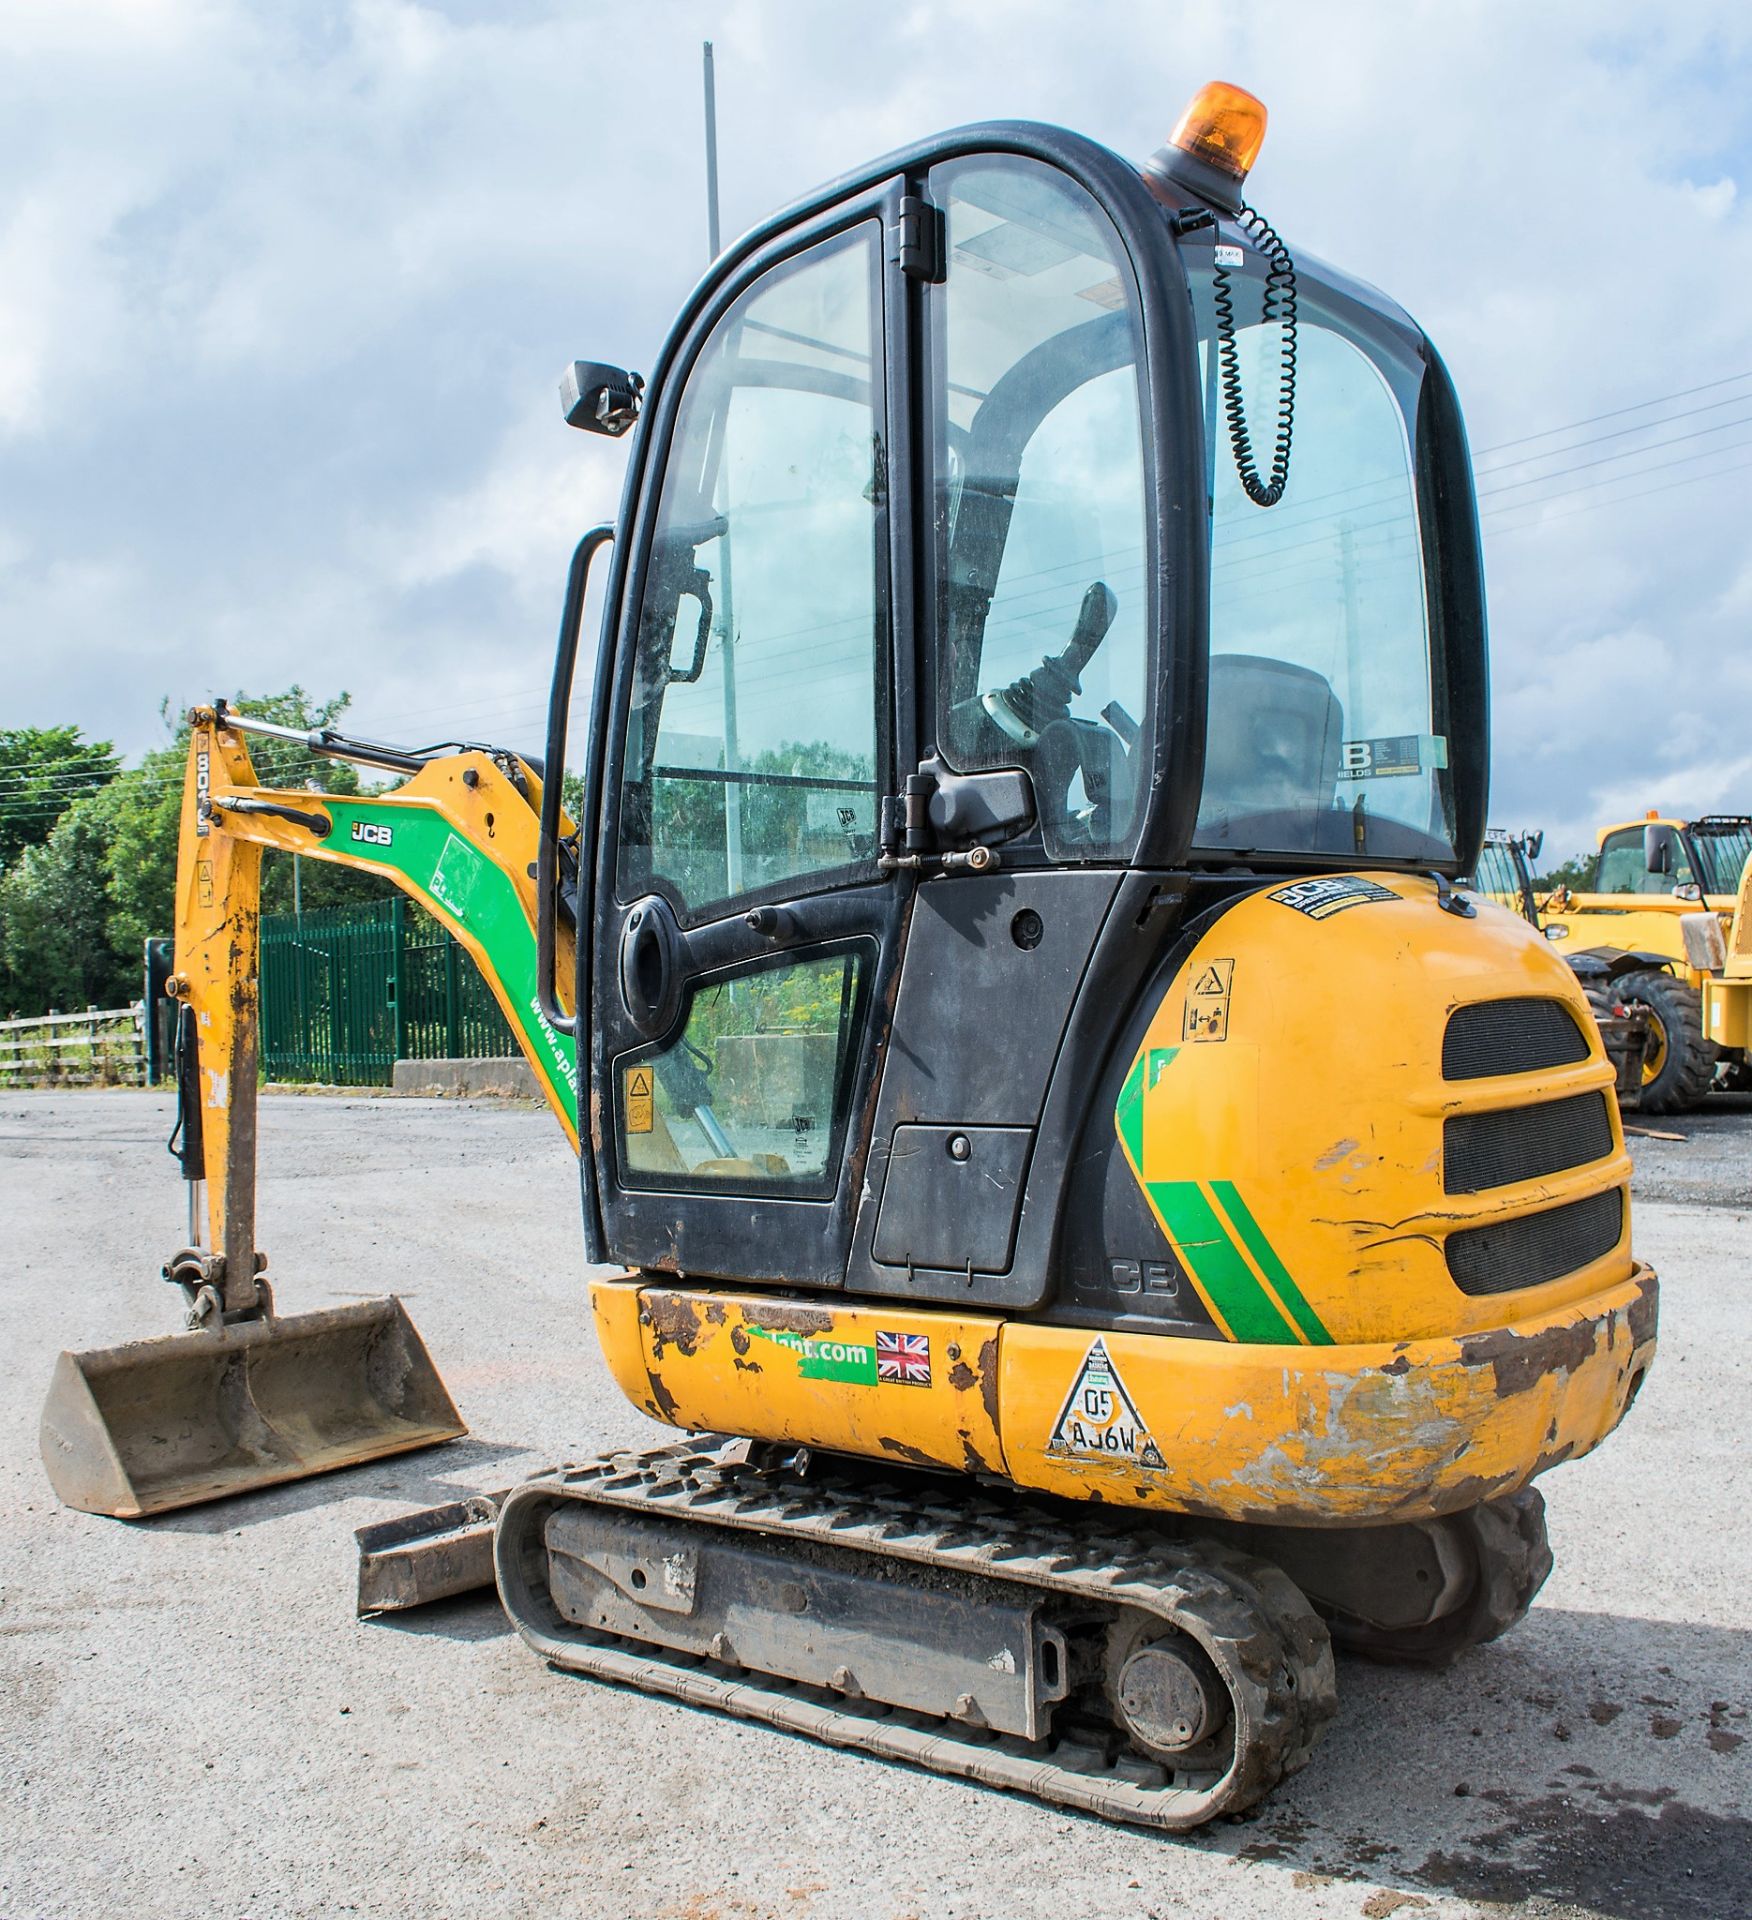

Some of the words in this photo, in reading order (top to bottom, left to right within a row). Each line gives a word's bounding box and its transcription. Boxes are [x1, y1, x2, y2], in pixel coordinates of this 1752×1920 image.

[840, 809, 855, 824] JCB
[352, 822, 393, 846] JCB
[1275, 880, 1344, 906] JCB
[529, 996, 577, 1096] www.apla
